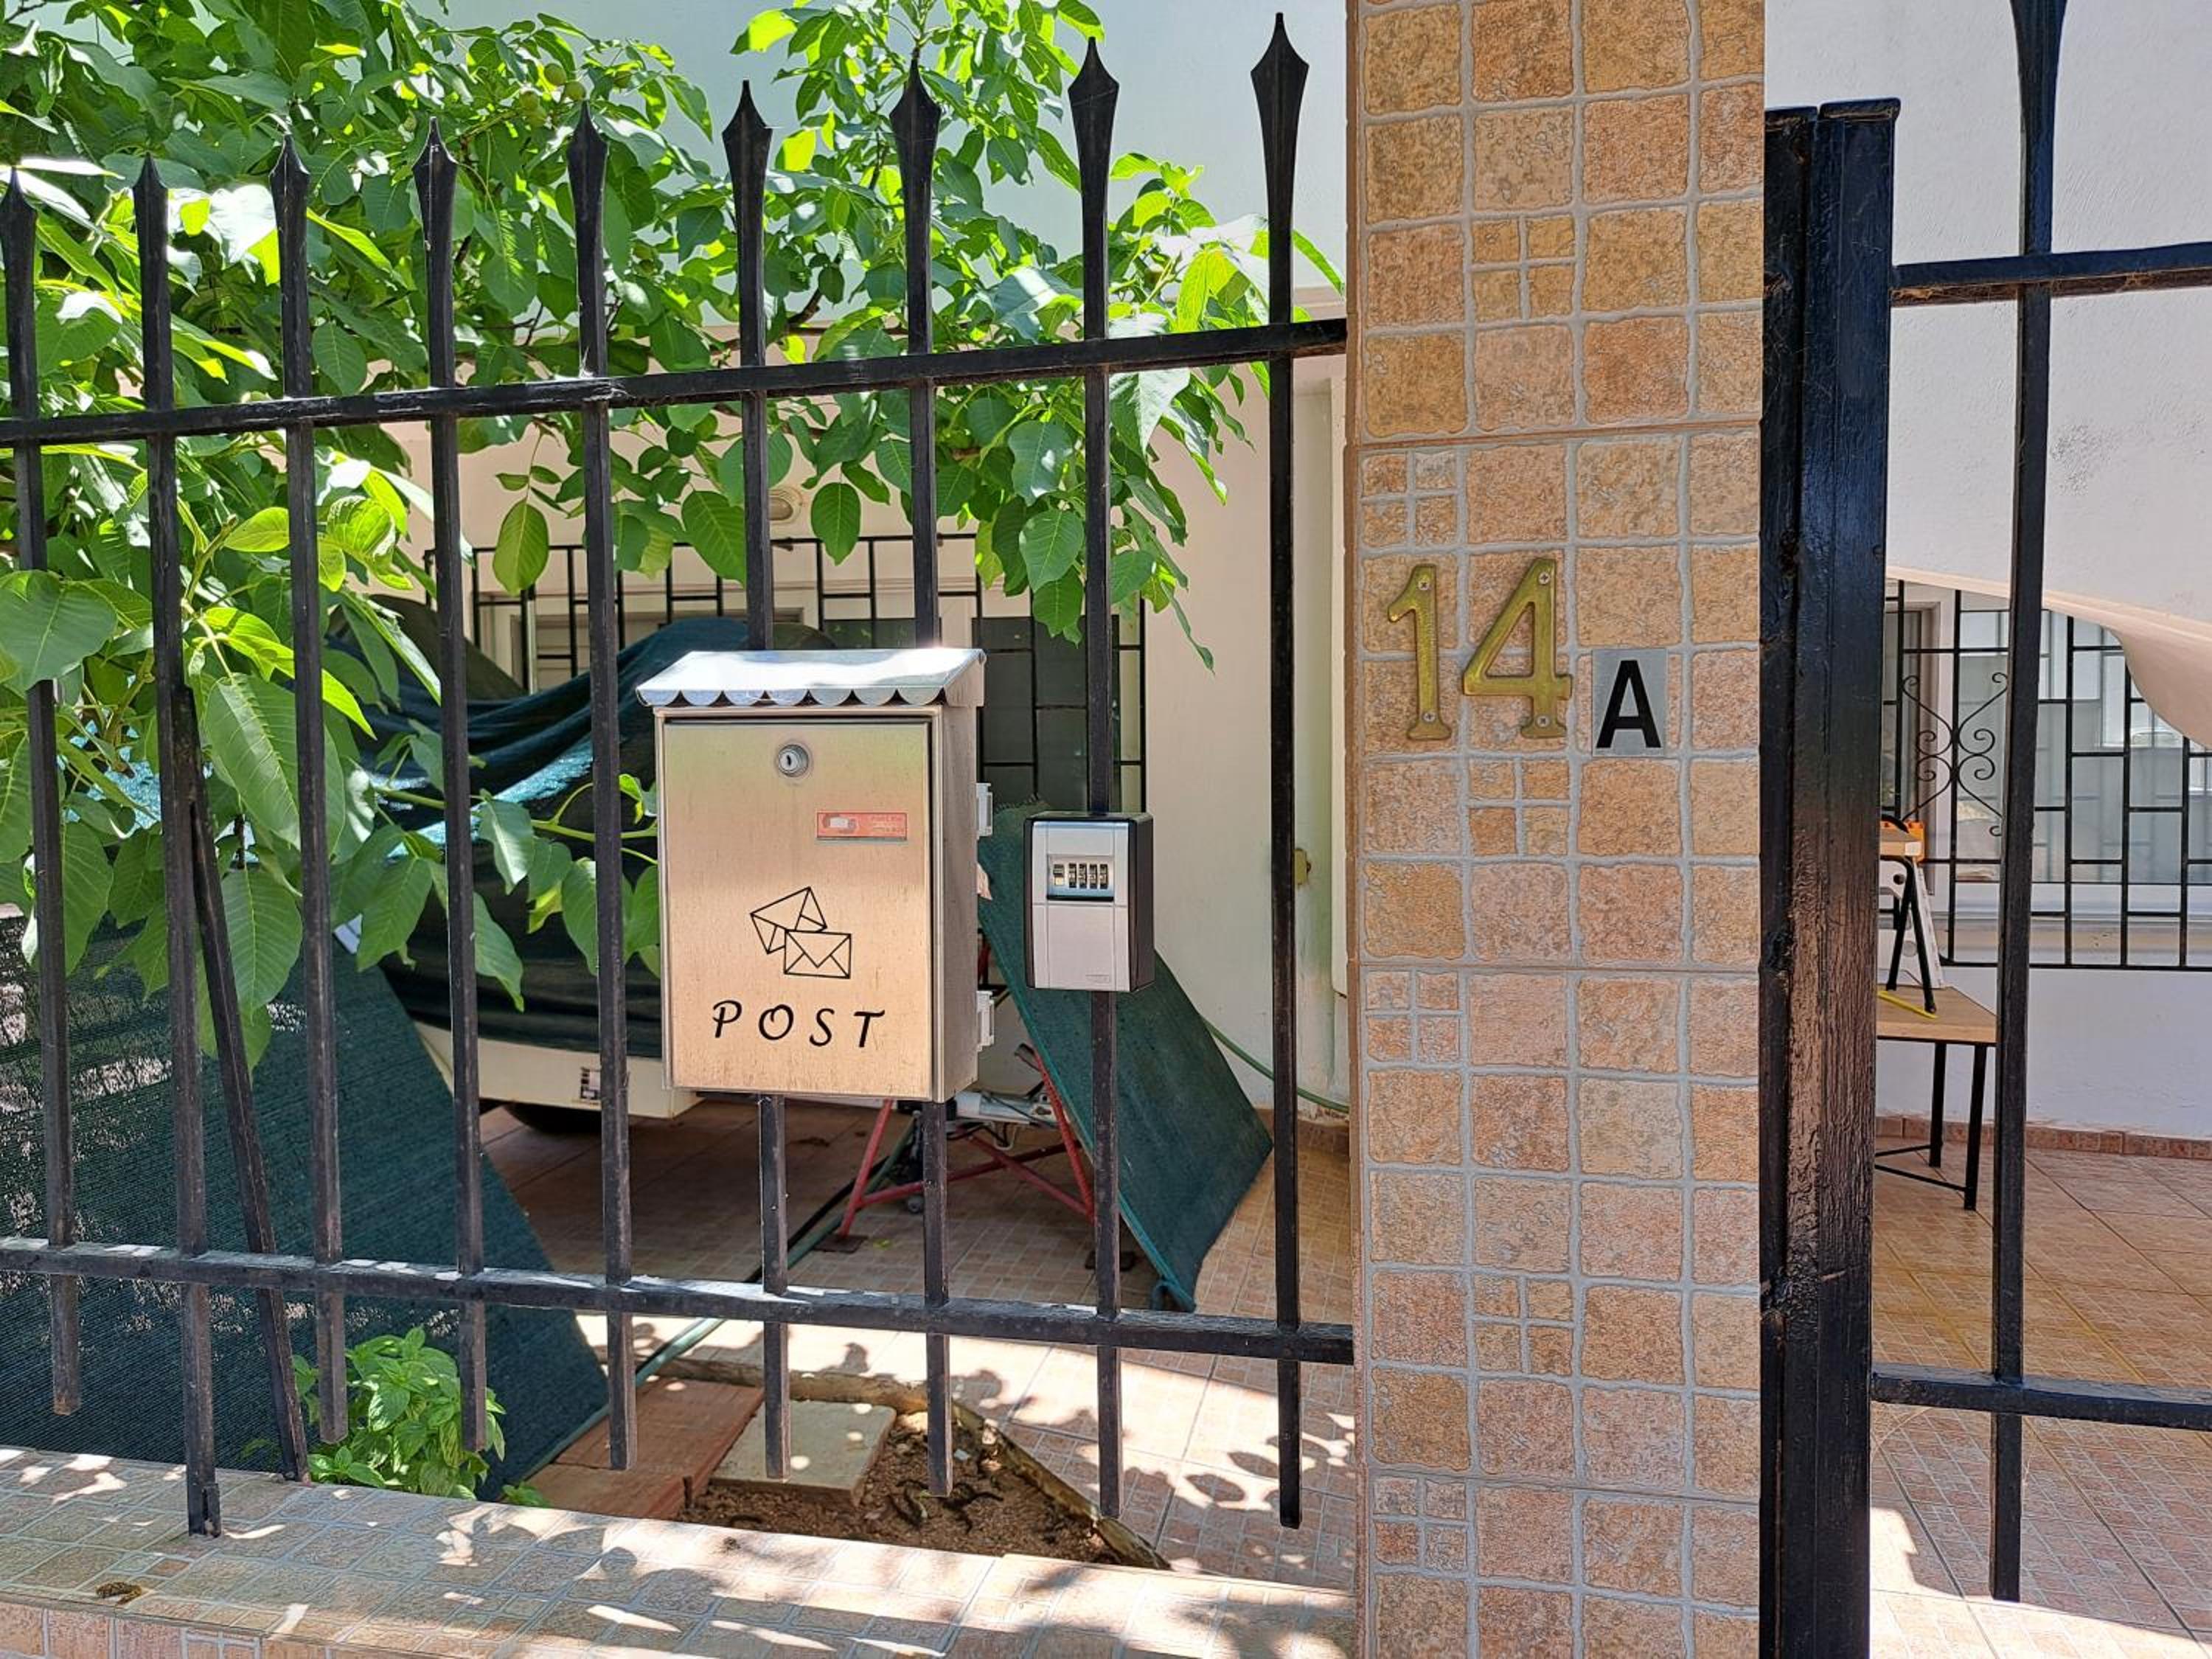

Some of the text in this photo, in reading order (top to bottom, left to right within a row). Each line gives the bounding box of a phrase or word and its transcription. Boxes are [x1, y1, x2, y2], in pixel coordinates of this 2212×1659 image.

[1388, 559, 1662, 748] 14 A
[712, 1000, 886, 1048] POST
